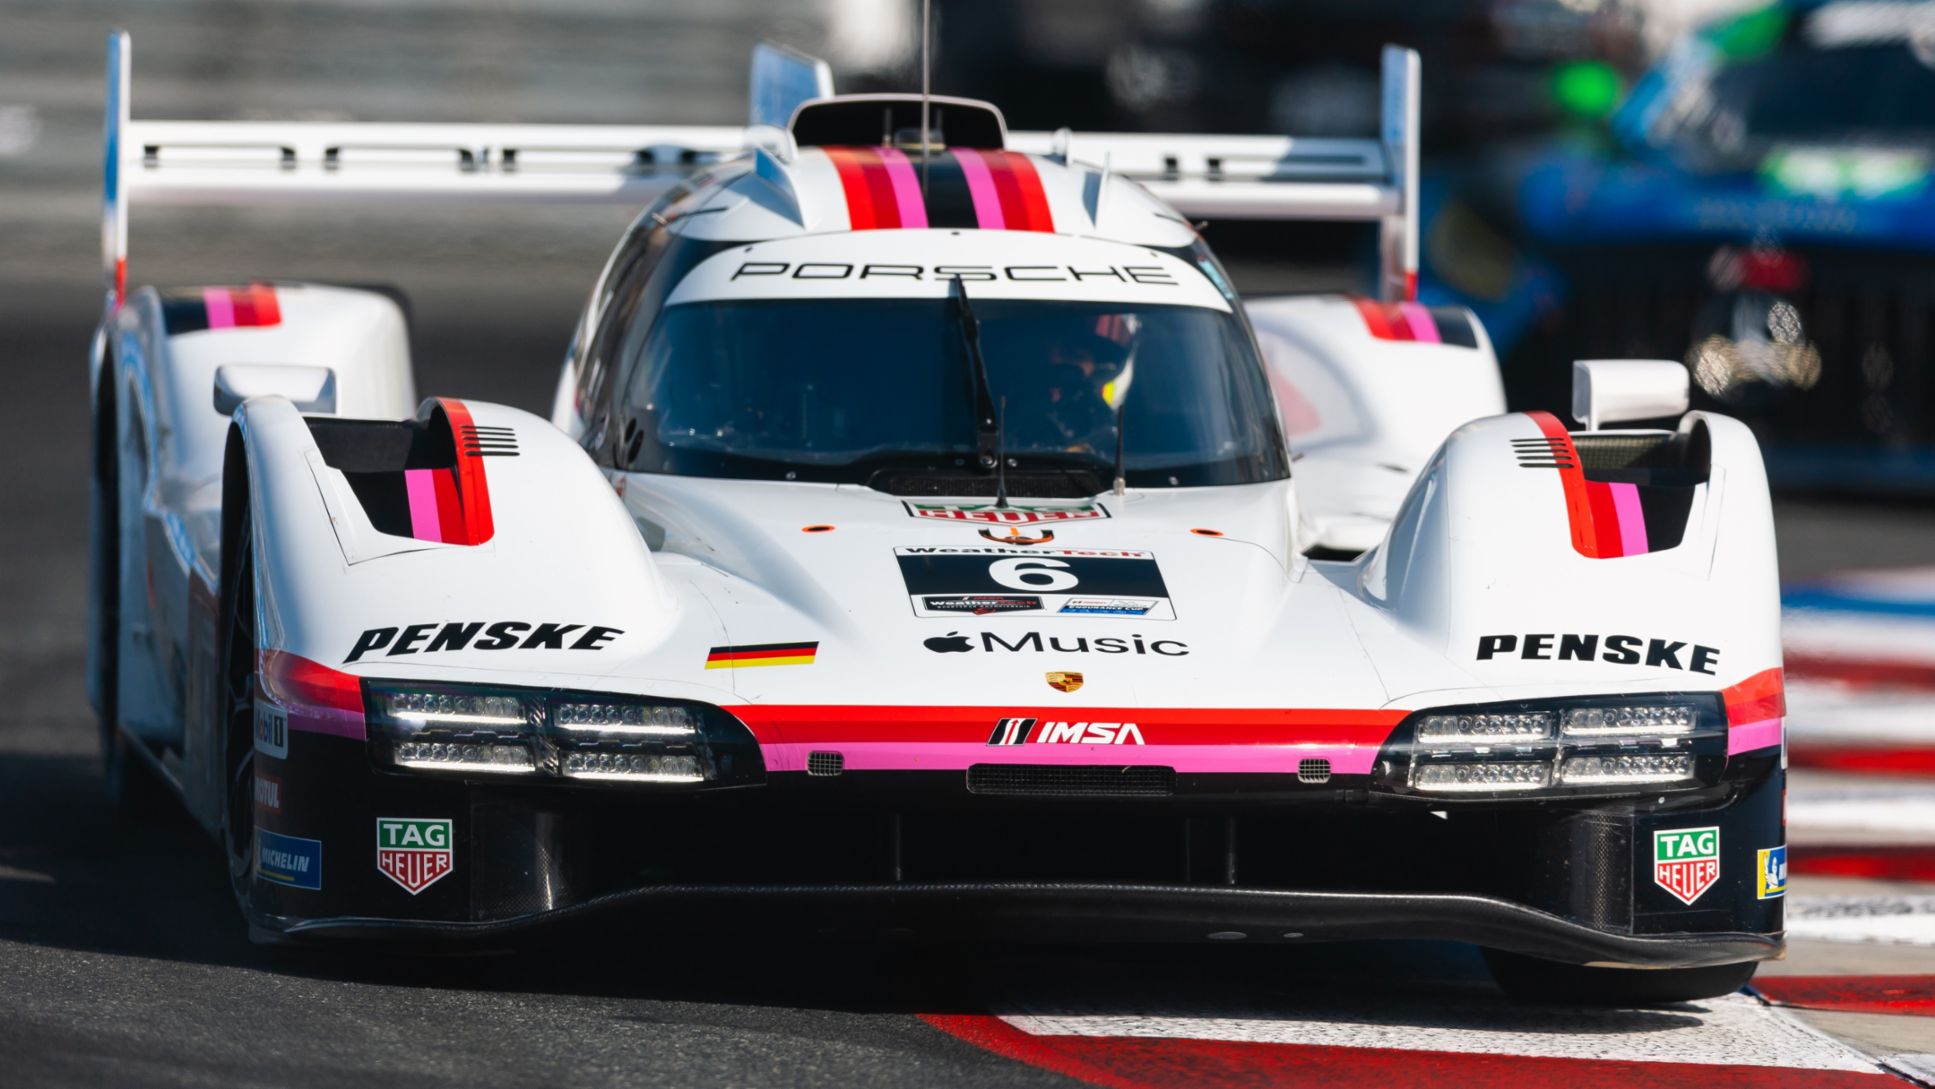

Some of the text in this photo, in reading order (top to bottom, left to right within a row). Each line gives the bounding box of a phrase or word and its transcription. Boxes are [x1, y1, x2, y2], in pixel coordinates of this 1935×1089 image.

[730, 262, 1178, 285] PORSCHE
[905, 547, 1143, 557] WeatherTech
[988, 557, 1079, 591] 6
[342, 621, 625, 664] PENSKE
[981, 631, 1189, 656] Music
[1476, 633, 1720, 676] PENSKE
[1036, 721, 1145, 745] IMSA
[383, 824, 445, 846] TAG
[1660, 833, 1714, 857] TAG
[262, 848, 310, 872] MICHELIN
[382, 853, 447, 888] HEUER
[1660, 862, 1716, 898] HEUER
